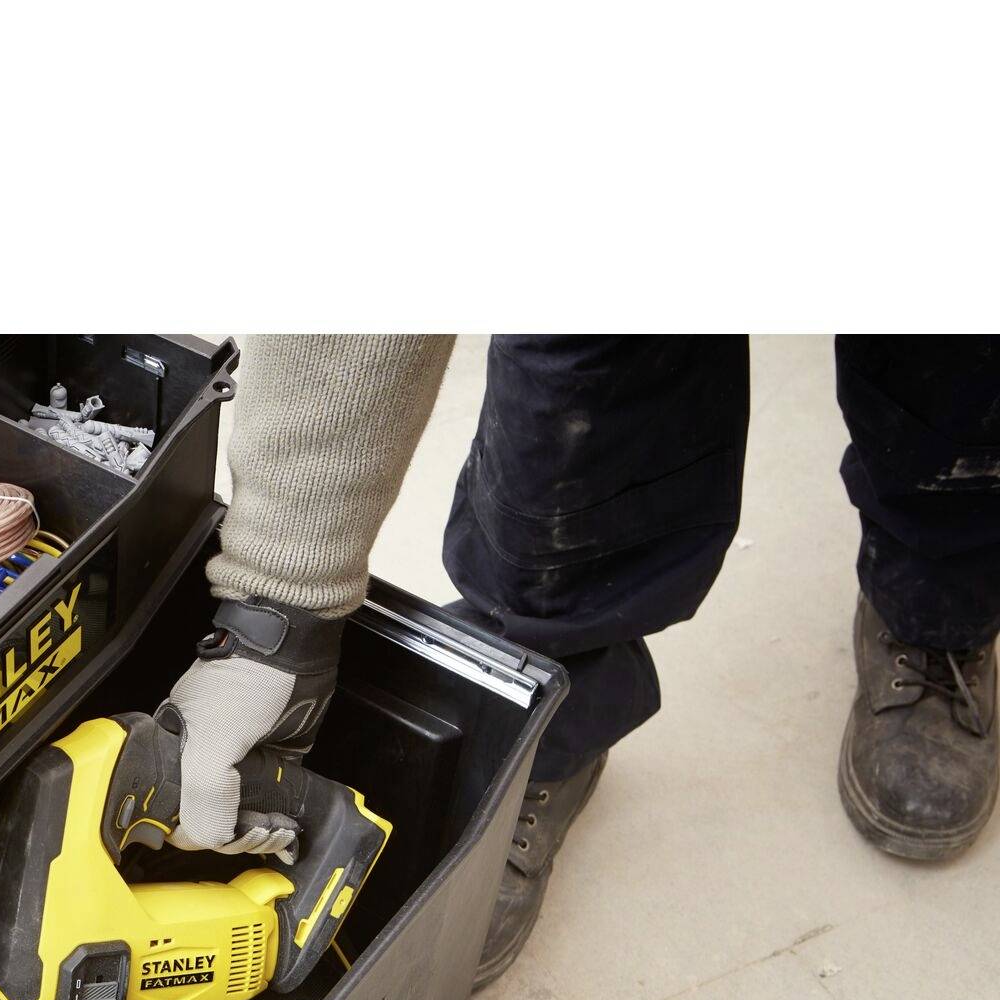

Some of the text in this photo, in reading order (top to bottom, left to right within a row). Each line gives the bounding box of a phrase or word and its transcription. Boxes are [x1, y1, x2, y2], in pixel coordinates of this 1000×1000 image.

[141, 955, 216, 976] STANLEY
[75, 979, 82, 989] 0
[145, 973, 209, 988] FATMAX
